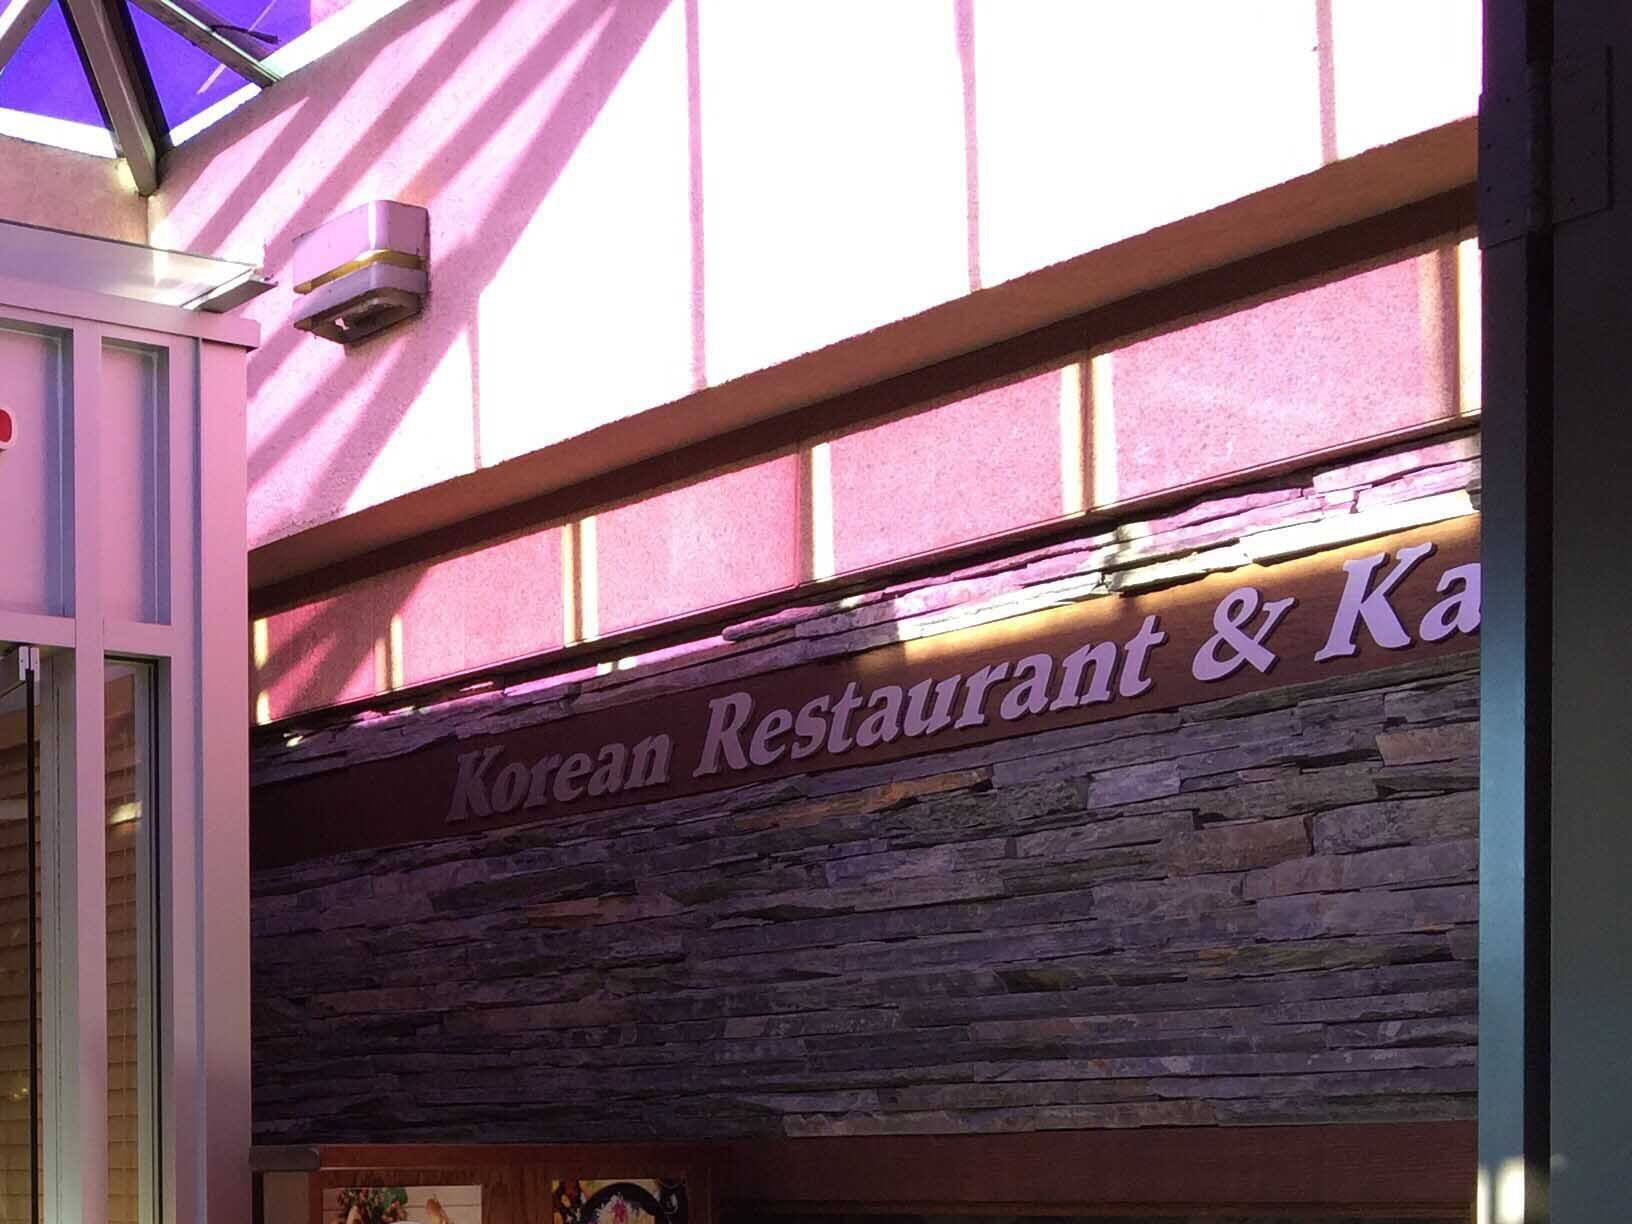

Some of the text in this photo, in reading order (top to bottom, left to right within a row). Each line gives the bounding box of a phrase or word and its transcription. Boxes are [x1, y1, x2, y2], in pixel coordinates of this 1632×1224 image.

[446, 733, 671, 823] Korean
[693, 614, 1165, 778] Restaurant
[1192, 587, 1294, 682] &
